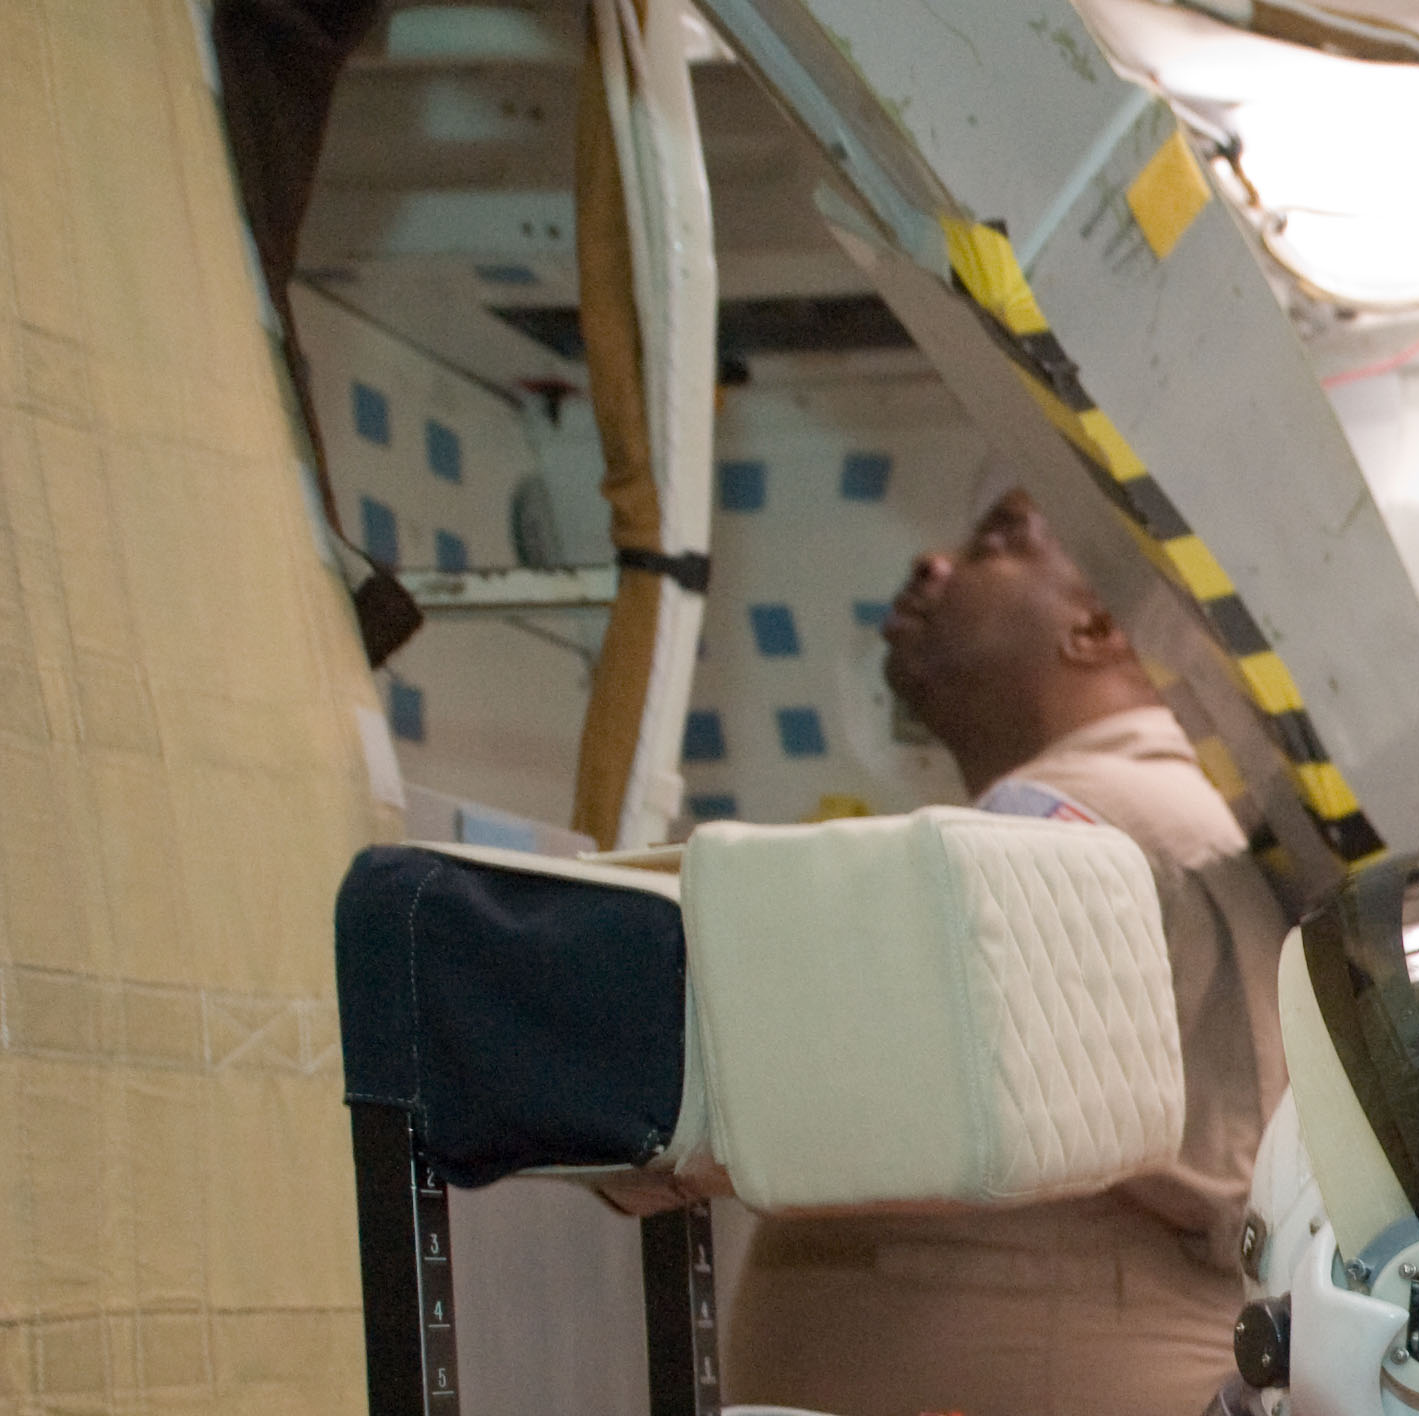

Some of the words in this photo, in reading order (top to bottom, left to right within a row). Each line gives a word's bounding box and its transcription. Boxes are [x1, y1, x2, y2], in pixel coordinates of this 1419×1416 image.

[430, 1234, 440, 1254] 3
[434, 1301, 443, 1321] 4
[438, 1368, 447, 1388] 5
